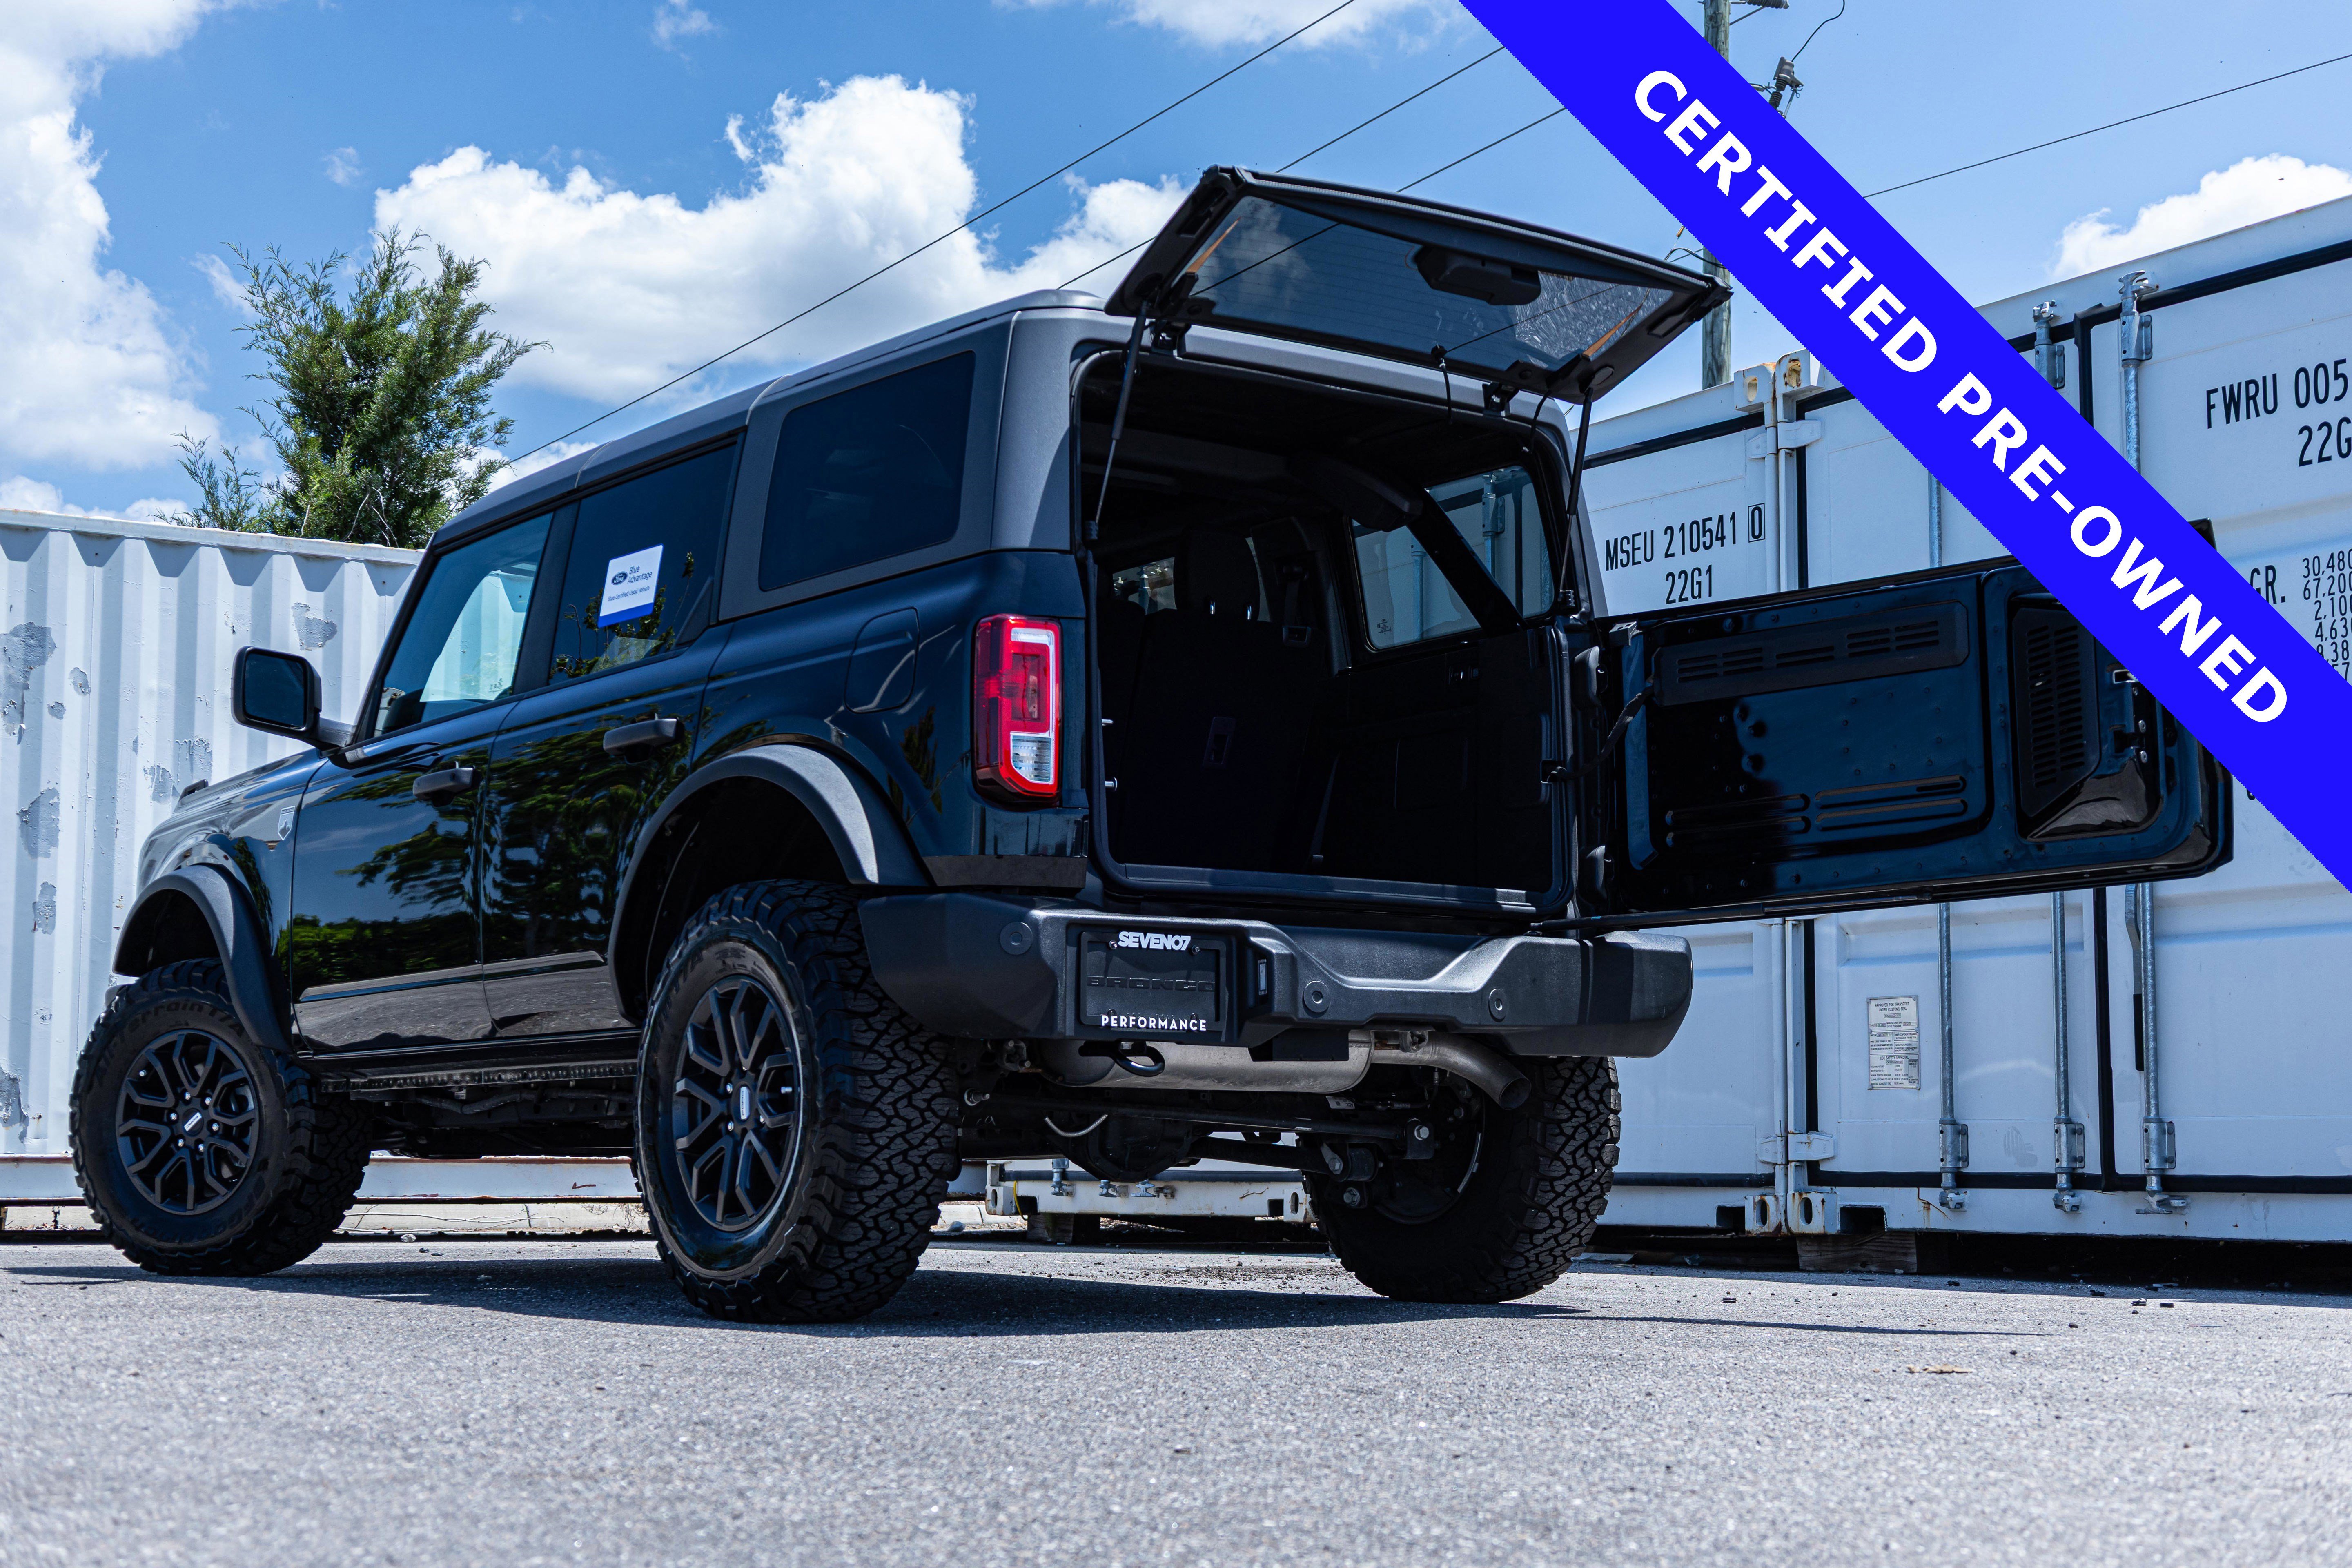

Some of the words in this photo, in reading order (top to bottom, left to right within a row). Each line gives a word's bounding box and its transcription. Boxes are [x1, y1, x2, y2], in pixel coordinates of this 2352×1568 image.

[2206, 373, 2278, 429] FWRU
[2294, 358, 2348, 408] 005
[2298, 417, 2352, 467] 22G
[1606, 530, 1654, 571] MSEU
[1664, 512, 1736, 559] 210541
[1750, 505, 1763, 540] 0
[627, 571, 653, 584] Advantage
[629, 566, 640, 574] Blue
[1665, 565, 1712, 605] 22G1
[2314, 594, 2352, 621] 2,10
[2315, 617, 2352, 642] 4,63
[1101, 1014, 1206, 1031] PERFORMANCE
